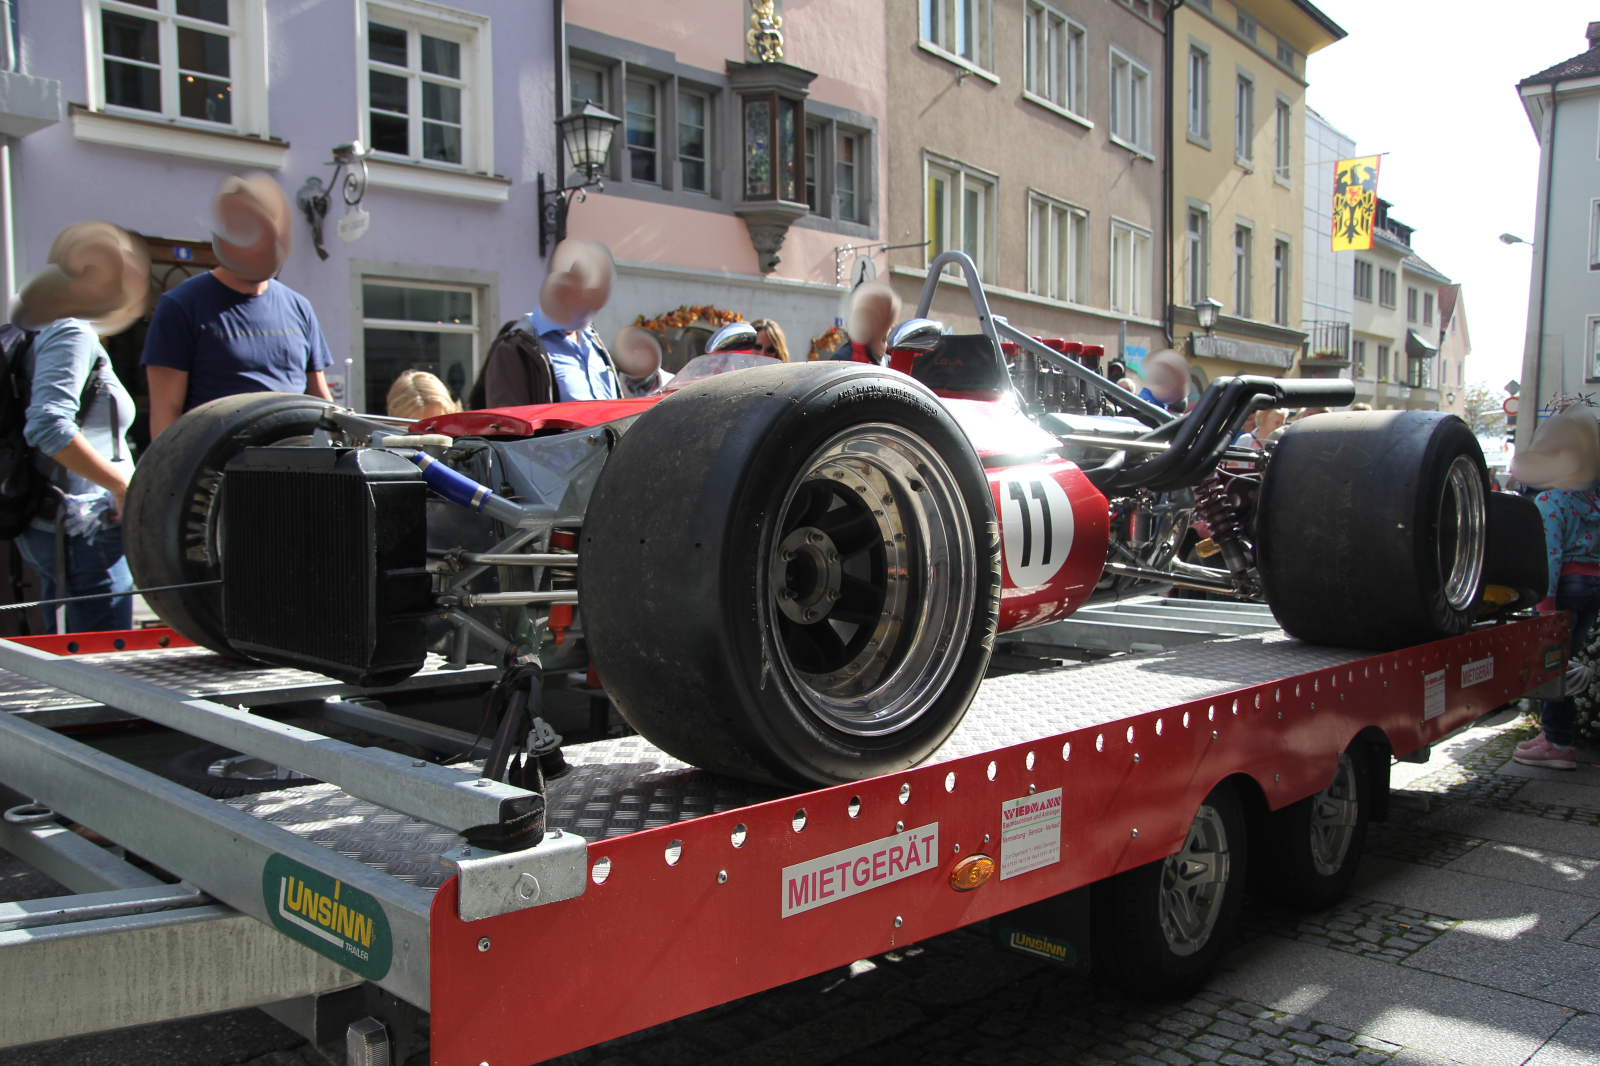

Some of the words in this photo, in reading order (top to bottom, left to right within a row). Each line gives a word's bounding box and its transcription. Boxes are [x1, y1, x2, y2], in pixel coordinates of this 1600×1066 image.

[934, 358, 964, 366] LOLA
[839, 388, 854, 399] FOR
[1007, 480, 1053, 568] 11
[1462, 660, 1493, 685] MIETGERÄT
[1003, 797, 1061, 821] WIEDMANN
[1003, 815, 1032, 829] Baumaschinen
[1042, 807, 1060, 819] Anhänger
[1003, 831, 1025, 845] Vermietung
[1029, 826, 1043, 836] Service
[1046, 821, 1060, 831] Verkauf
[788, 834, 936, 911] MIETGERÄT
[345, 942, 369, 962] TRAILER
